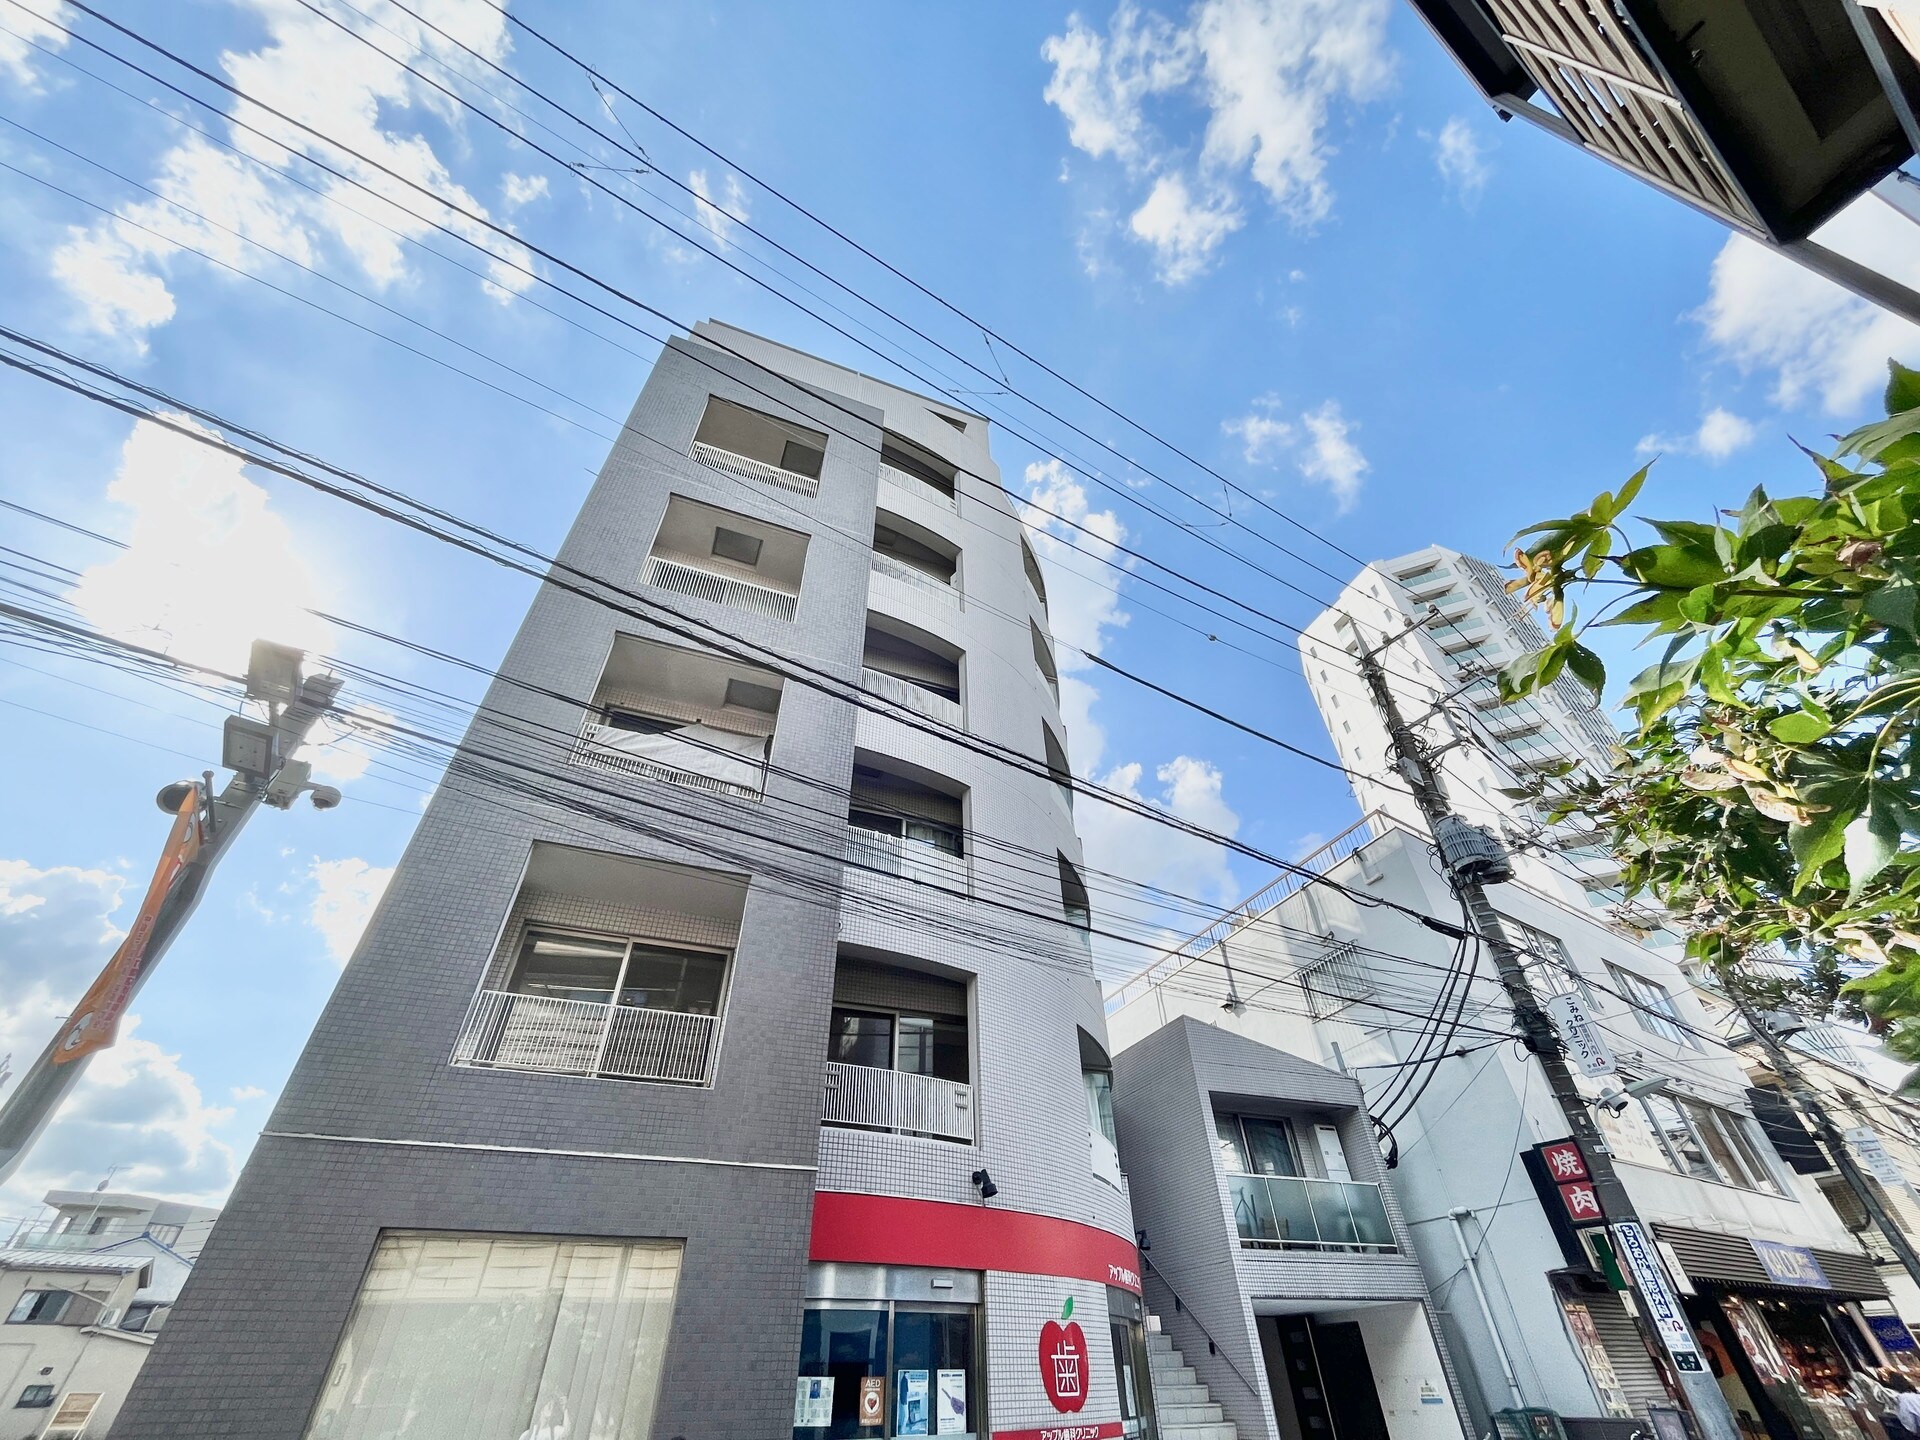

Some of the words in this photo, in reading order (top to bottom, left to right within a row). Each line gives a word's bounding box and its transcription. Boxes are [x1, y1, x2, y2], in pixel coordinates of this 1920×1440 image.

[1565, 996, 1584, 1022] こみね
[1551, 1148, 1599, 1214] 焼肉
[865, 1379, 881, 1388] AED
[1050, 1339, 1080, 1397] 歯
